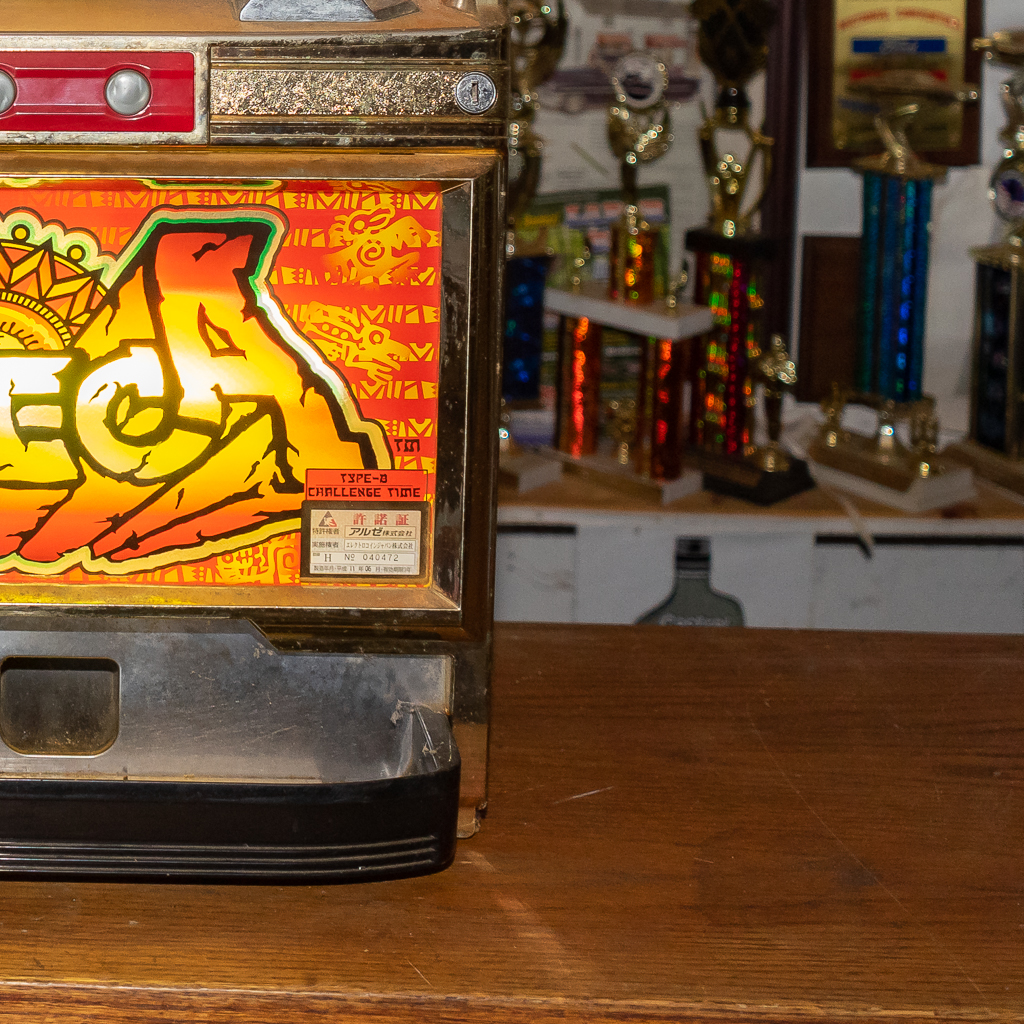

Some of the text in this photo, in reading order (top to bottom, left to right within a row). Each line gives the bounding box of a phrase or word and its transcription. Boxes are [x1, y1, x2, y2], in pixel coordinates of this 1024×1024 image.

[308, 488, 420, 498] CHALLENGE TIME
[348, 528, 412, 536] アルゼ株式会社
[324, 554, 332, 562] H
